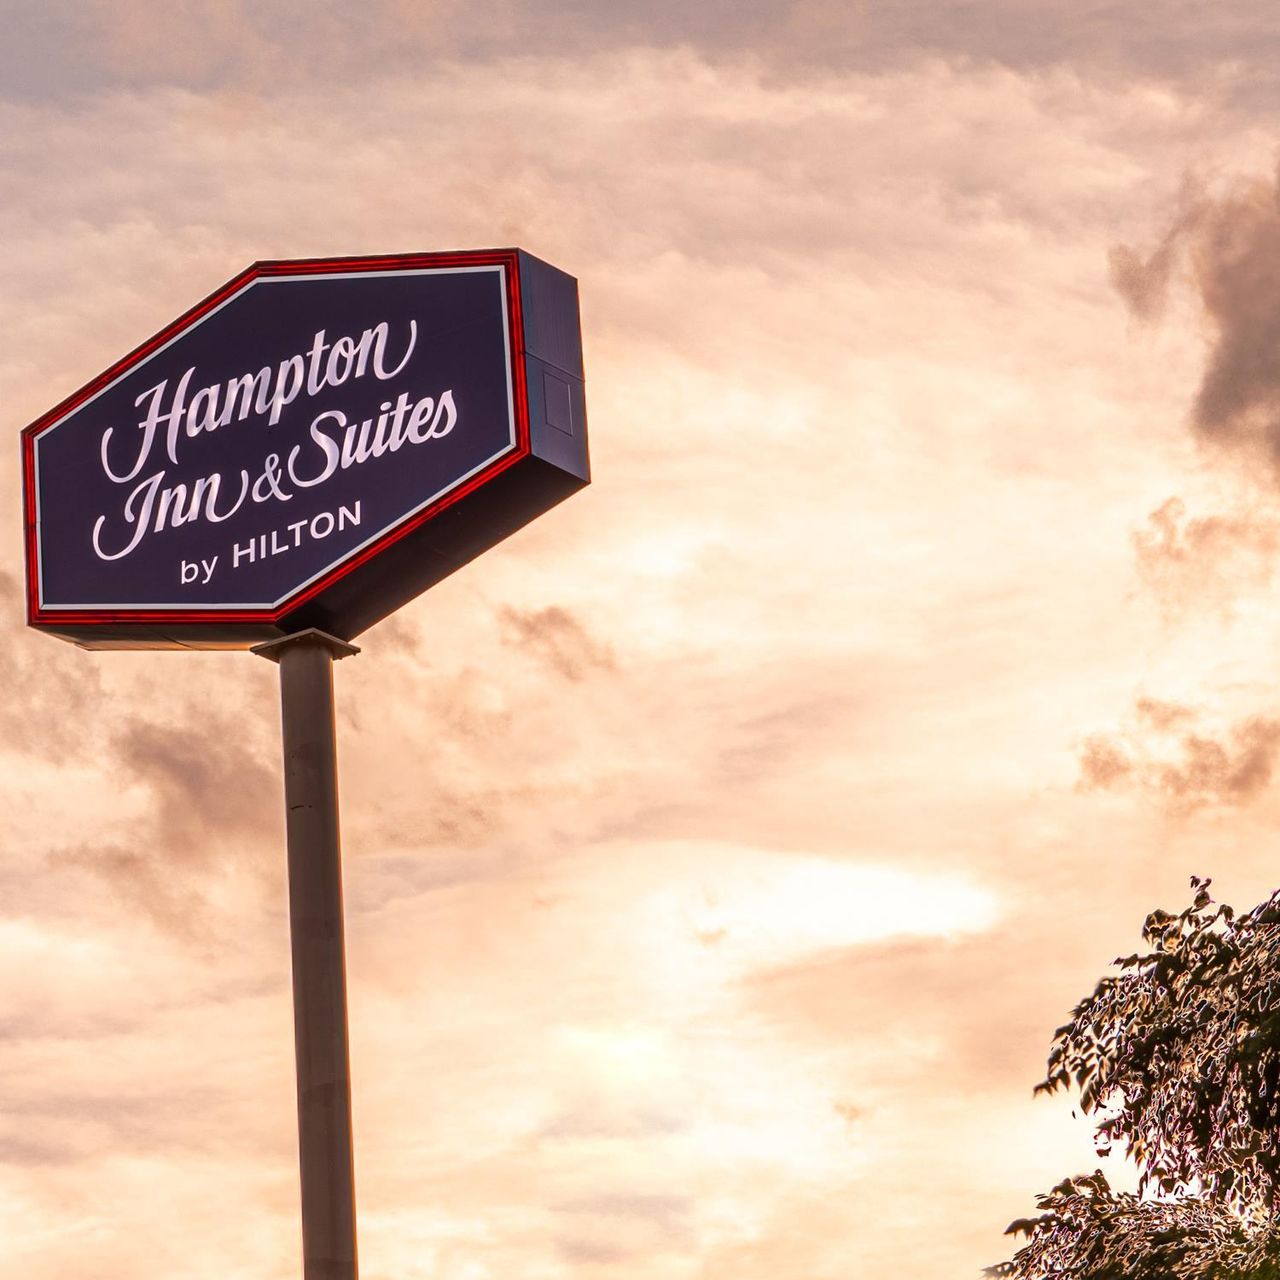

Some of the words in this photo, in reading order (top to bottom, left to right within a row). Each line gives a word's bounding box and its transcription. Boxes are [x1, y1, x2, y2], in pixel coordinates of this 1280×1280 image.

[92, 469, 249, 561] Inn
[251, 453, 293, 503] &
[287, 389, 458, 488] Suites
[100, 319, 418, 484] Hampton
[180, 555, 219, 585] by
[232, 500, 362, 568] HILTON
